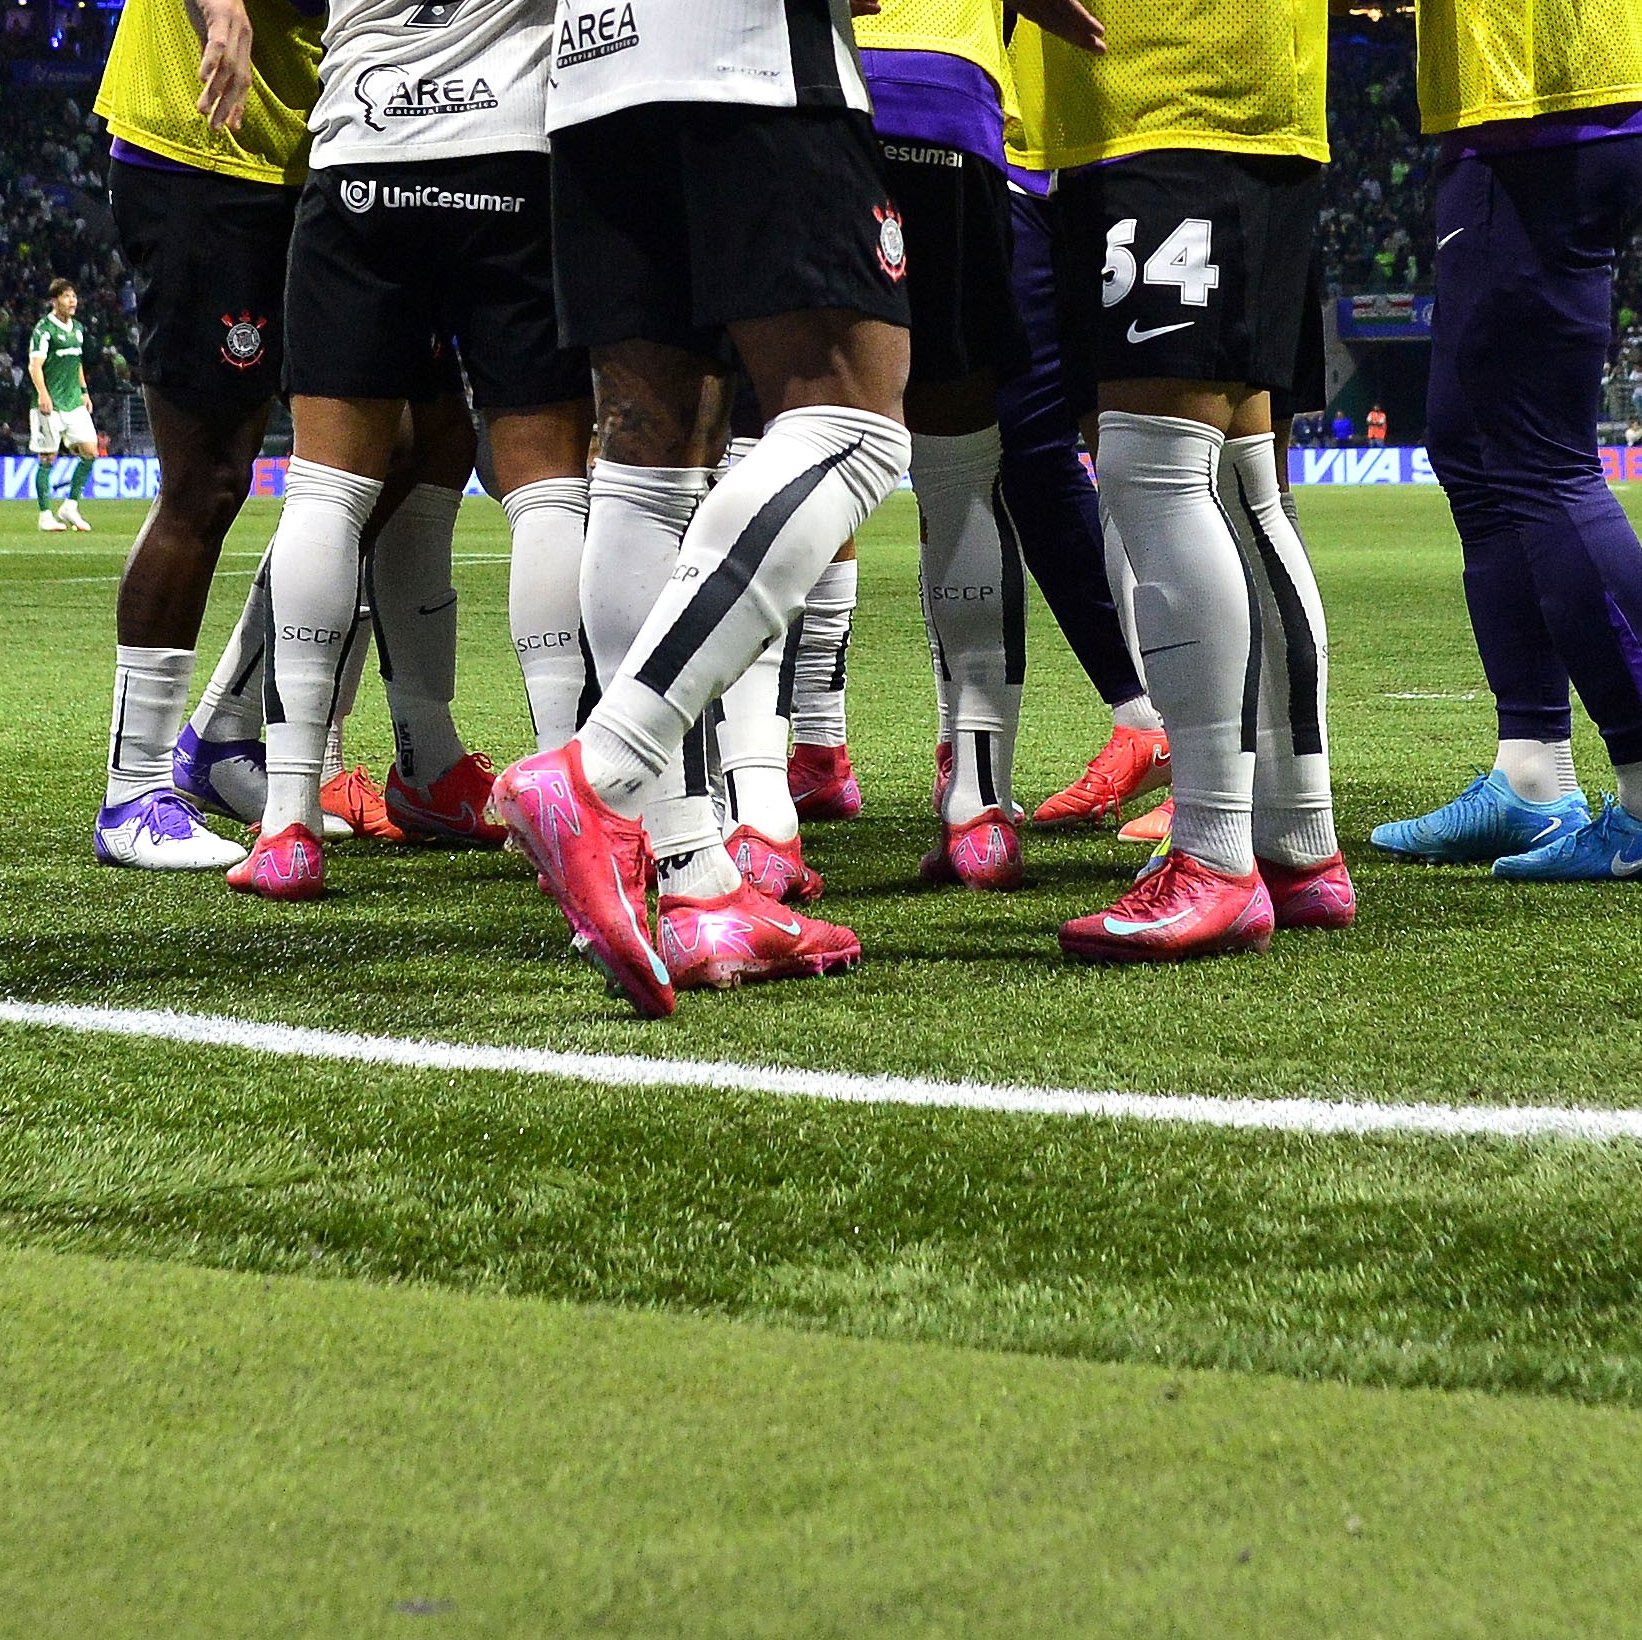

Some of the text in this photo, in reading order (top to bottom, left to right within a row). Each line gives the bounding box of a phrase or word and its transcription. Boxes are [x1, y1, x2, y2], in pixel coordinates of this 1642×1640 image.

[558, 1, 637, 55] AREA
[387, 77, 496, 106] AREA
[382, 185, 526, 213] UniCesumar
[1303, 447, 1400, 484] VIVA
[933, 586, 995, 601] SCCP
[281, 625, 342, 645] SCCP
[517, 631, 572, 653] SCCP
